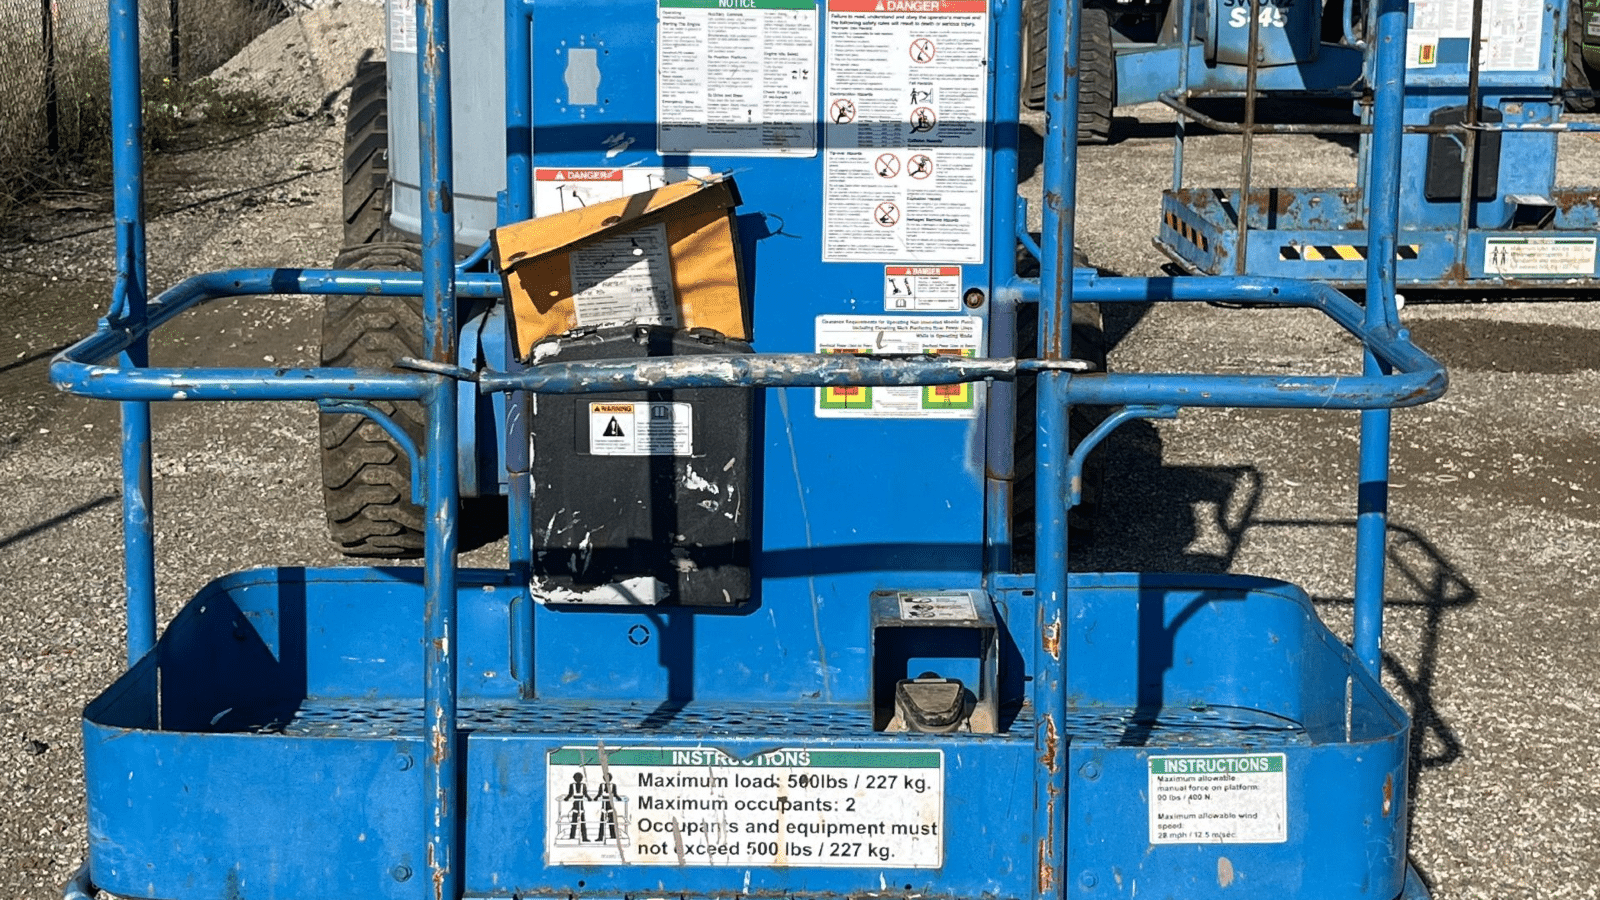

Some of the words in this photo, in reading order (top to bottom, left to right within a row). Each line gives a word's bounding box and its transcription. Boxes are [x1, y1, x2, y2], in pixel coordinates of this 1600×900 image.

[887, 0, 940, 11] DANGER
[568, 171, 609, 179] DANGER
[1164, 758, 1269, 773] INSTRUCTIONS
[638, 773, 728, 789] Maximum
[735, 773, 780, 789] load:
[788, 774, 848, 789] 500lbs
[854, 774, 860, 789] /
[866, 776, 898, 789] 227
[904, 776, 931, 793] kg.
[638, 796, 728, 811] Maximum
[735, 797, 838, 814] occupants:
[846, 798, 856, 812] 2
[745, 820, 780, 834] and
[786, 820, 885, 837] equipment
[892, 822, 937, 835] must
[638, 842, 668, 855] not
[747, 842, 778, 856] 500
[786, 842, 812, 856] lbs
[818, 842, 825, 856] /
[830, 843, 861, 857] 227
[868, 843, 895, 861] kg.
